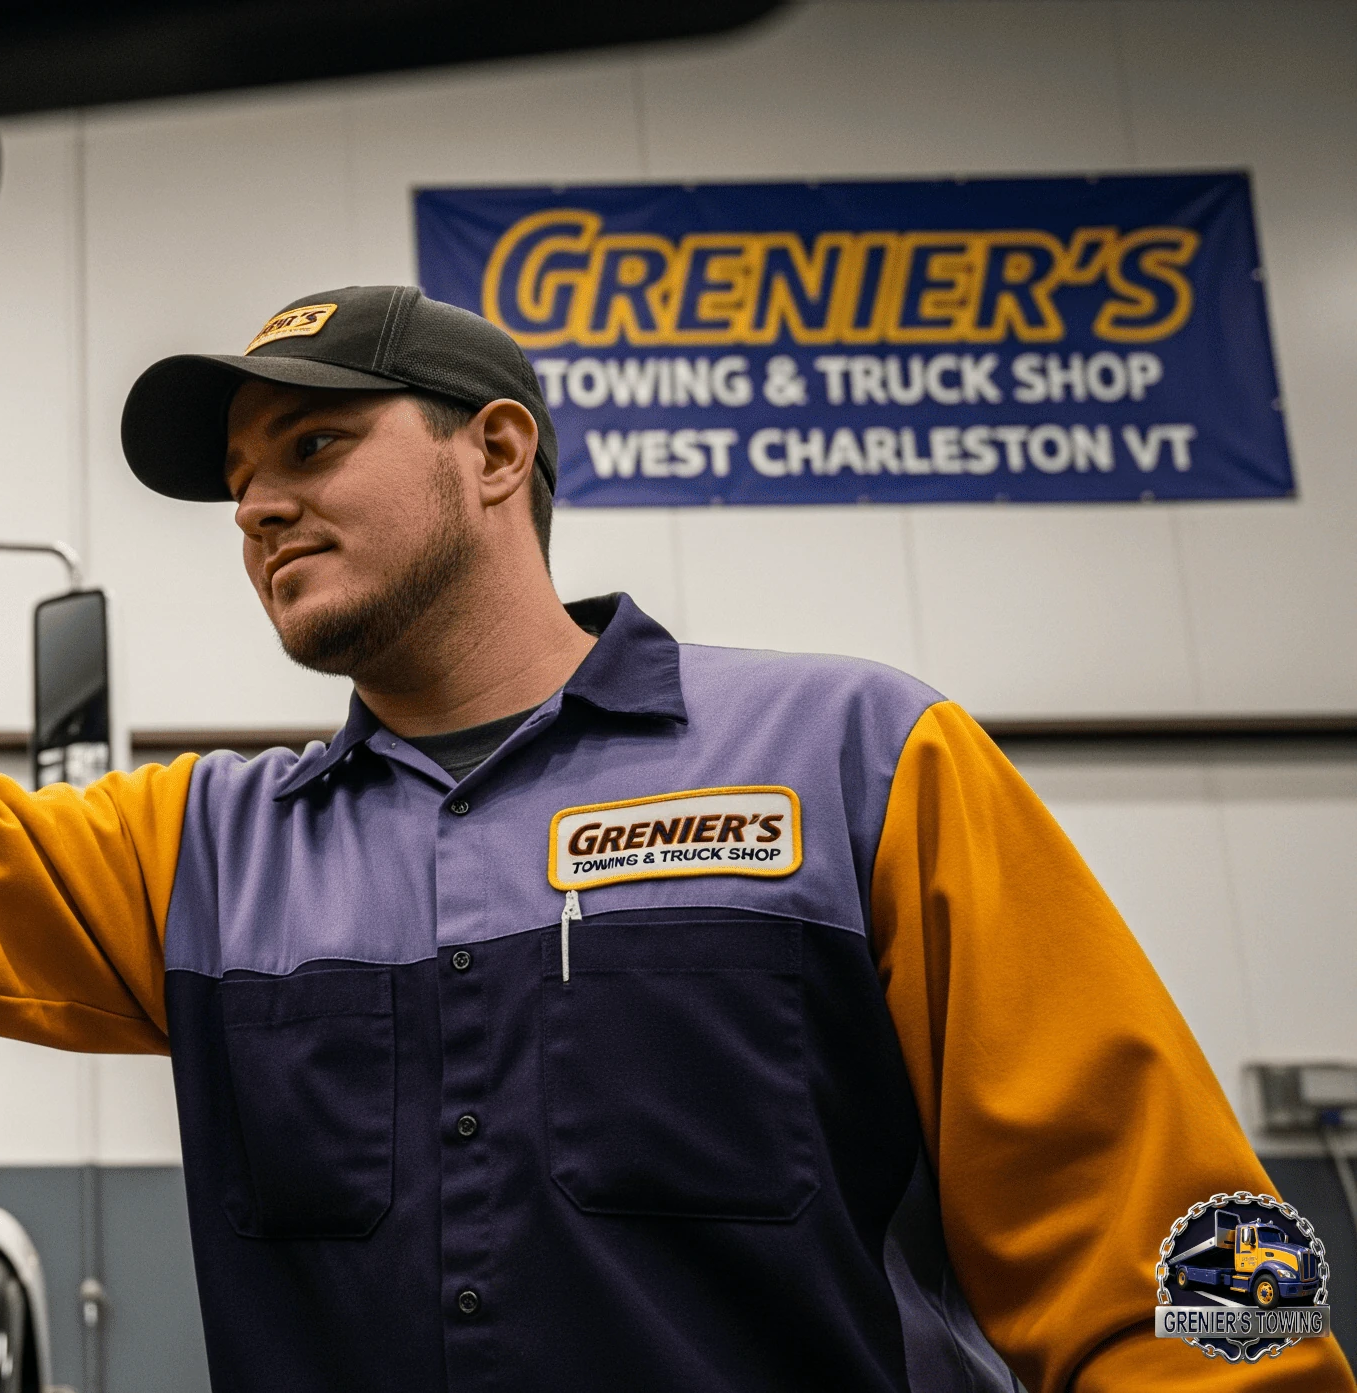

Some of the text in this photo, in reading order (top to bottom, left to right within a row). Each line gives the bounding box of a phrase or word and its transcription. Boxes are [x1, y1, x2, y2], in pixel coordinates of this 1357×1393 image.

[480, 209, 1202, 346] GRENIER'S
[537, 352, 1163, 408] TOWING & TRUCK SHOP
[585, 424, 1196, 479] WEST CHARLESTON VT
[569, 814, 784, 856] GRENIER'S
[643, 852, 655, 864] &
[660, 847, 724, 863] TRUCK
[727, 848, 781, 861] SHOP
